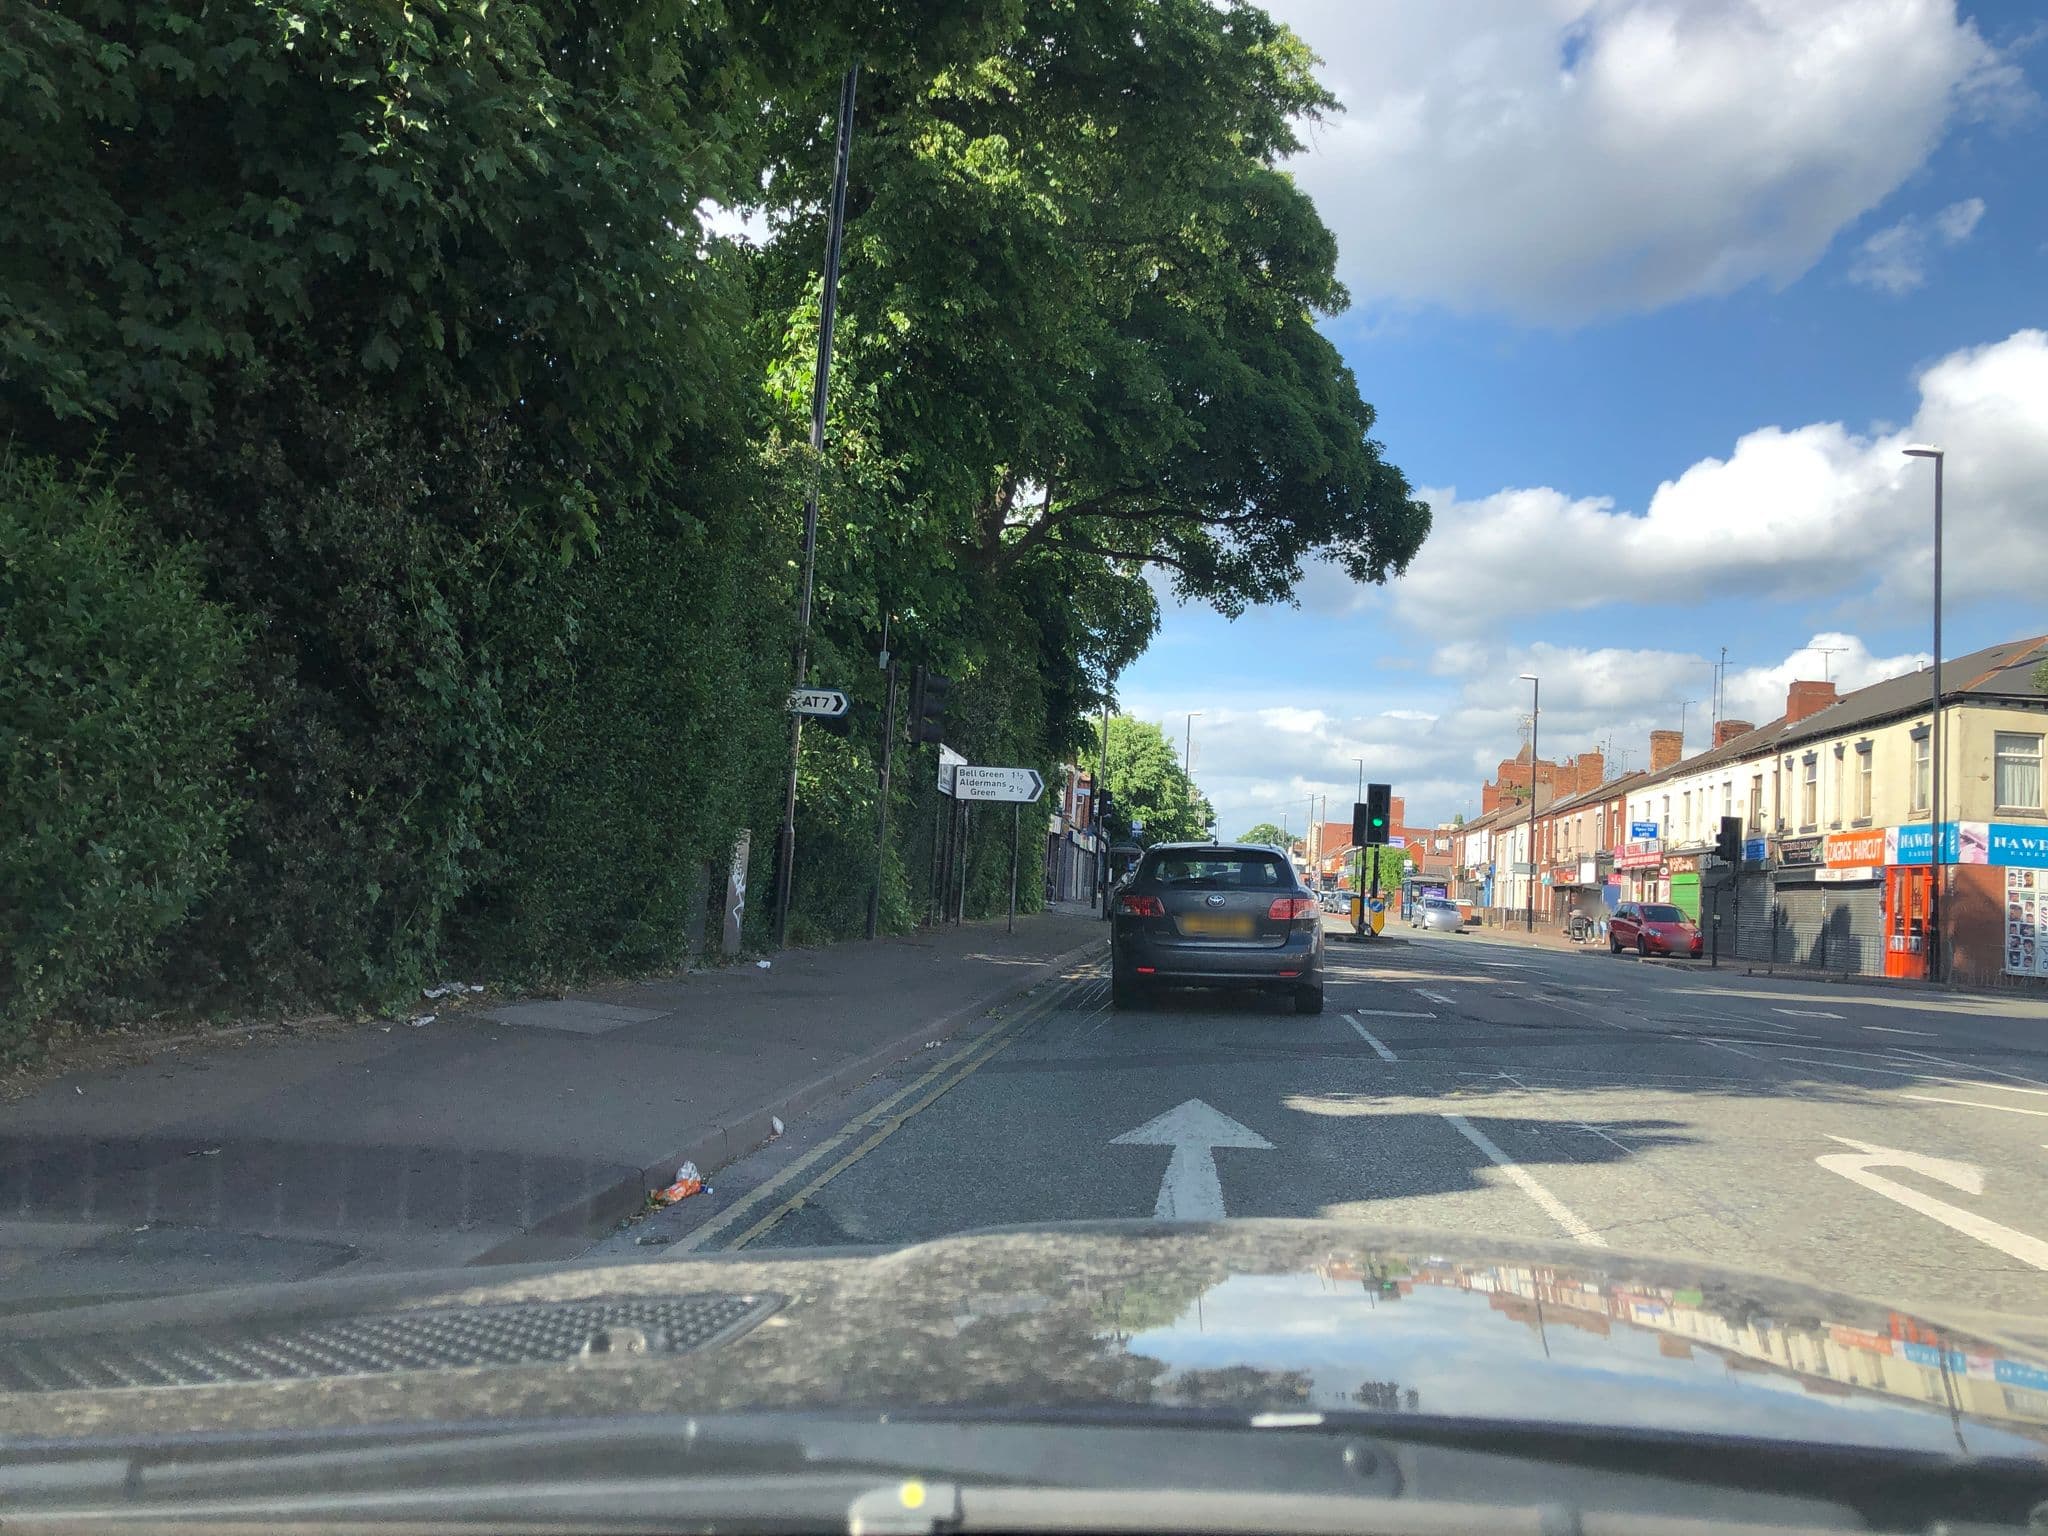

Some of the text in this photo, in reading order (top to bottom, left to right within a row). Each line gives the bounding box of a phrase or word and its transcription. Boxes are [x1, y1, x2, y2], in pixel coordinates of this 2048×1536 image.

[959, 769, 977, 777] Bell
[979, 769, 1005, 779] Green
[959, 778, 1007, 788] Aldermans
[970, 788, 996, 797] Green
[1828, 840, 1851, 861] ZAGROS
[1853, 838, 1883, 860] HAIRCUT
